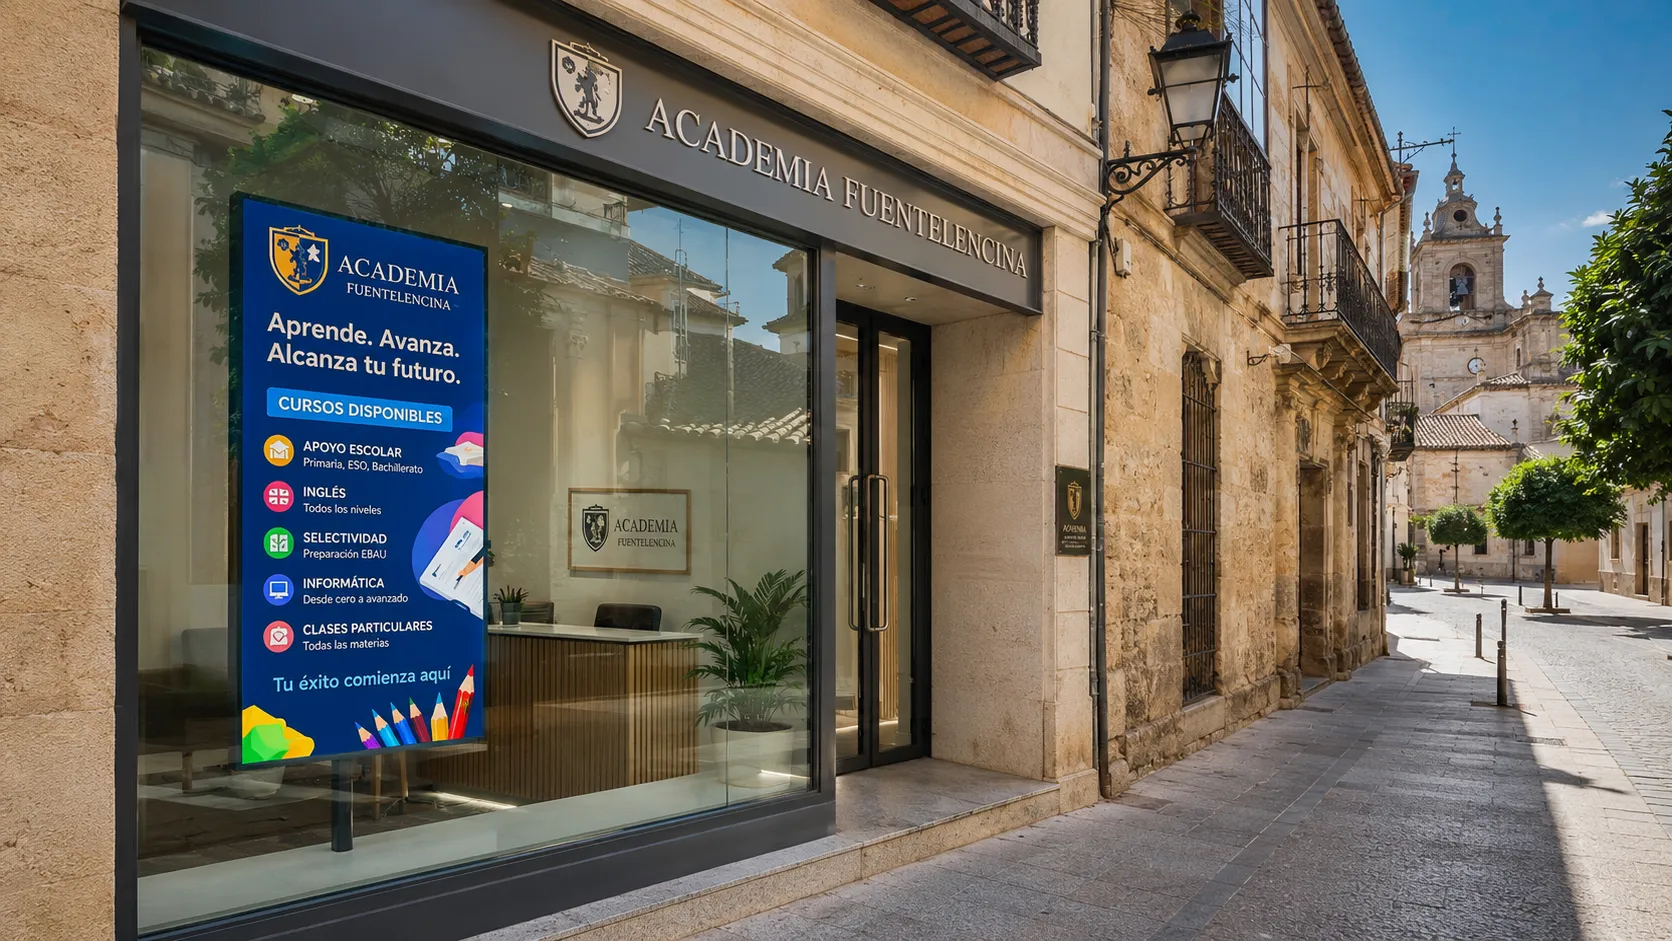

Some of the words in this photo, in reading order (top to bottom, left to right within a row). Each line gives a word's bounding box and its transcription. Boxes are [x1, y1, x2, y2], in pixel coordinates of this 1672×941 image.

[644, 98, 834, 202] ACADEMIA
[842, 175, 1028, 279] FUENTELENCINA
[338, 255, 459, 294] ACADEMIA
[347, 282, 451, 310] FUENTELENCINA
[267, 312, 373, 346] Aprende.
[379, 329, 460, 357] Avanza.
[267, 342, 357, 372] Alcanza
[364, 356, 386, 375] tu
[392, 358, 461, 384] futuro.
[278, 396, 344, 415] CURSOS
[349, 403, 442, 424] DISPONIBLES
[303, 440, 346, 454] APOYO
[350, 445, 402, 458] ESCOLAR
[303, 458, 345, 470] Primaria,
[348, 460, 370, 472] ESO,
[372, 462, 424, 474] Bachillerato
[303, 485, 346, 498] INGLÉS
[303, 503, 332, 513] Todos
[334, 503, 348, 514] los
[350, 504, 382, 515] niveles
[614, 519, 678, 532] ACADEMIA
[303, 532, 387, 544] SELECTIVIDAD
[303, 549, 359, 561] Preparación
[361, 549, 387, 559] EBAU
[303, 575, 384, 589] INFORMÁTICA
[303, 594, 333, 604] Desde
[335, 596, 356, 604] cero
[358, 596, 364, 604] a
[366, 593, 408, 604] avanzado
[303, 623, 348, 636] CLASES
[351, 620, 433, 634] PARTICULARES
[303, 641, 332, 651] Todas
[334, 640, 348, 650] las
[350, 638, 390, 649] materias
[273, 677, 293, 692] Tu
[299, 673, 339, 691] éxito
[344, 669, 416, 687] comienza
[420, 665, 451, 684] aquí
